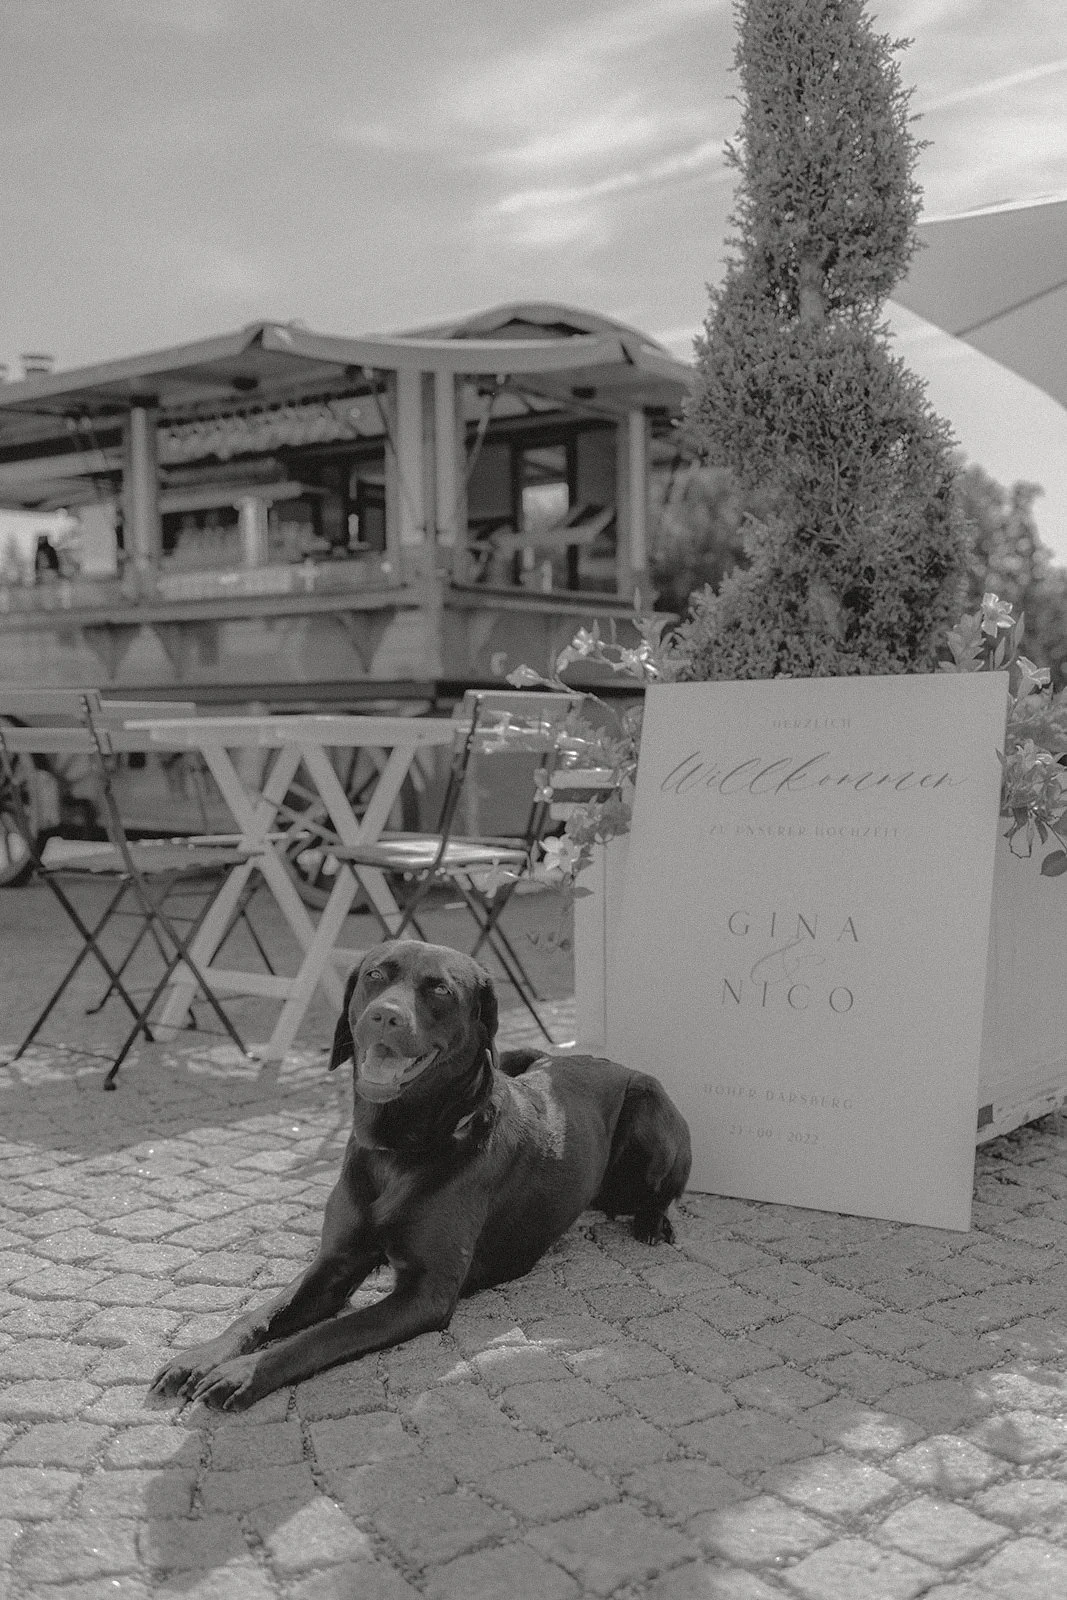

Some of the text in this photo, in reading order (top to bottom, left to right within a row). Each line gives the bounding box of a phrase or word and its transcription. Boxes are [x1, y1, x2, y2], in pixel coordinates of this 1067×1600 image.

[659, 750, 969, 796] Willkommen
[727, 909, 859, 943] GINA
[720, 977, 855, 1014] NICO
[786, 1131, 820, 1146] 2022
